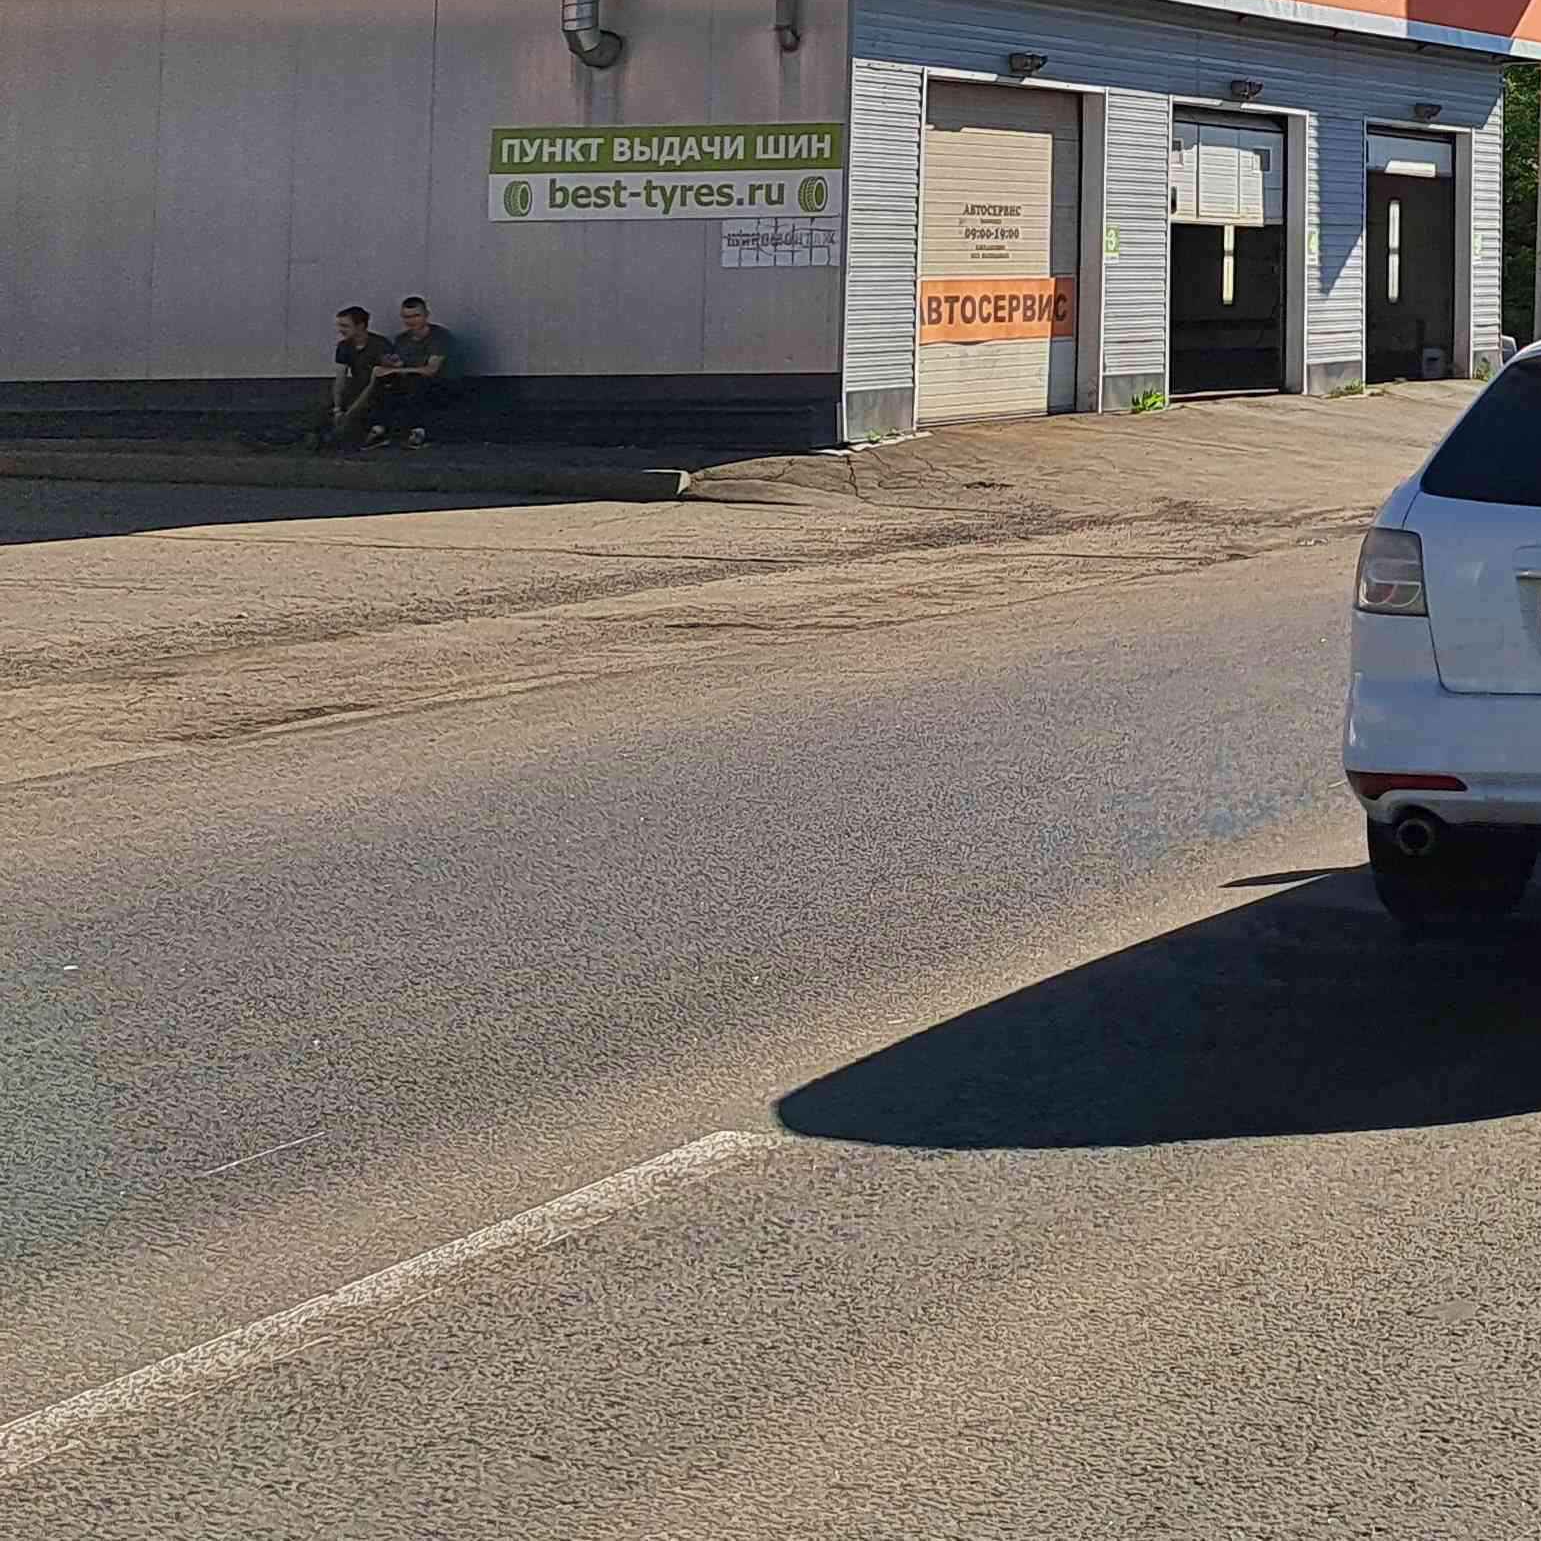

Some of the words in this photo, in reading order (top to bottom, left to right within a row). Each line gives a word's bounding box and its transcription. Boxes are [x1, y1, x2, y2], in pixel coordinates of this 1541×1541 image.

[501, 137, 605, 164] ПУНКТ
[613, 135, 745, 166] ВЫДАЧИ
[756, 134, 831, 159] ШИН
[549, 179, 785, 215] best-tyres.ru
